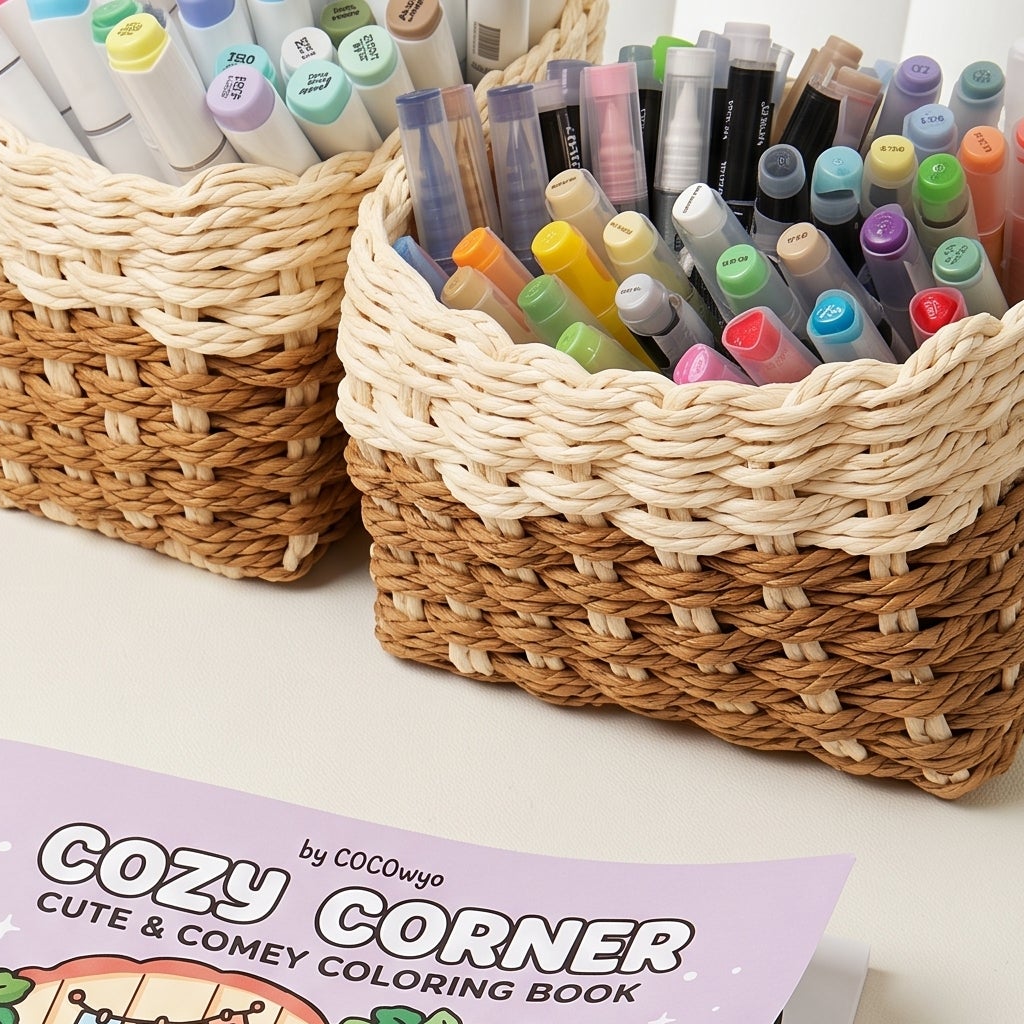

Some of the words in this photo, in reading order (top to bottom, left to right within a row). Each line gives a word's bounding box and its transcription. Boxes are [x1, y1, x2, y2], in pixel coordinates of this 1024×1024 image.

[37, 822, 291, 924] COZY
[314, 886, 695, 974] CORNER
[298, 838, 328, 867] by
[37, 892, 133, 930] CUTE
[141, 915, 164, 939] &
[177, 925, 309, 969] COMEY
[317, 956, 514, 1001] COLORING
[526, 983, 641, 1003] BOOK
